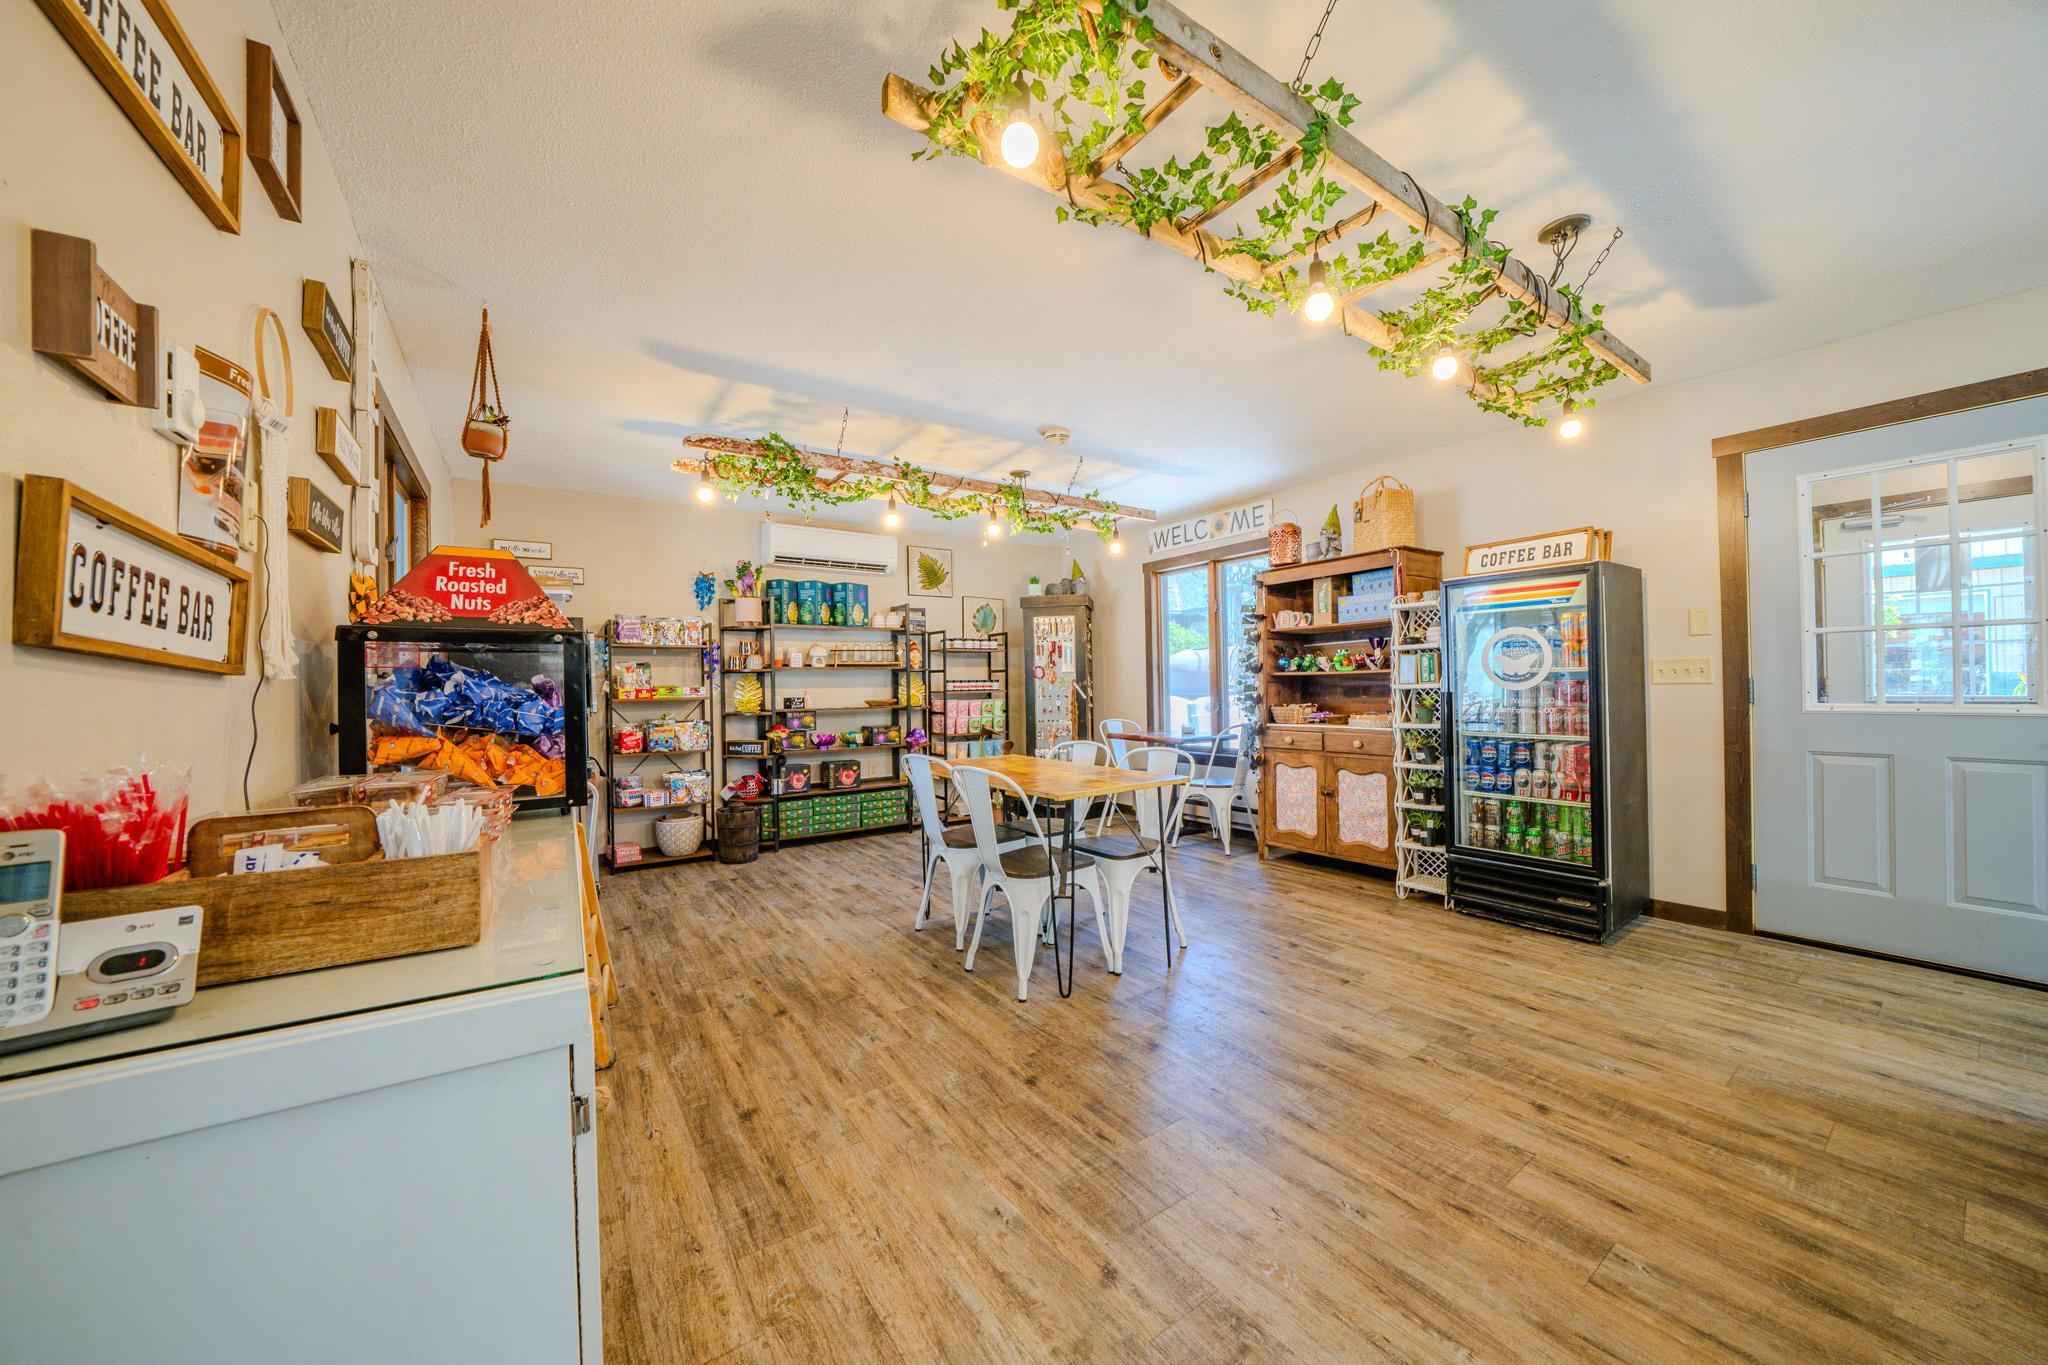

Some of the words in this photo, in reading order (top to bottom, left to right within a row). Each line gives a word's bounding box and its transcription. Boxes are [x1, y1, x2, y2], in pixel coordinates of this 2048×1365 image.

[171, 81, 207, 175] BAR
[1480, 546, 1536, 568] COFFEE
[1542, 541, 1573, 559] BAR
[448, 561, 496, 579] Fresh
[68, 542, 170, 630] COFFEE
[177, 585, 214, 642] BAR
[435, 575, 507, 594] Roasted
[450, 593, 491, 611] Nuts
[11, 945, 20, 956] 2
[40, 942, 49, 952] 3
[10, 961, 19, 972] 5
[38, 958, 48, 968] 6
[8, 977, 17, 989] 8
[37, 974, 46, 984] 9
[6, 994, 15, 1005] 0
